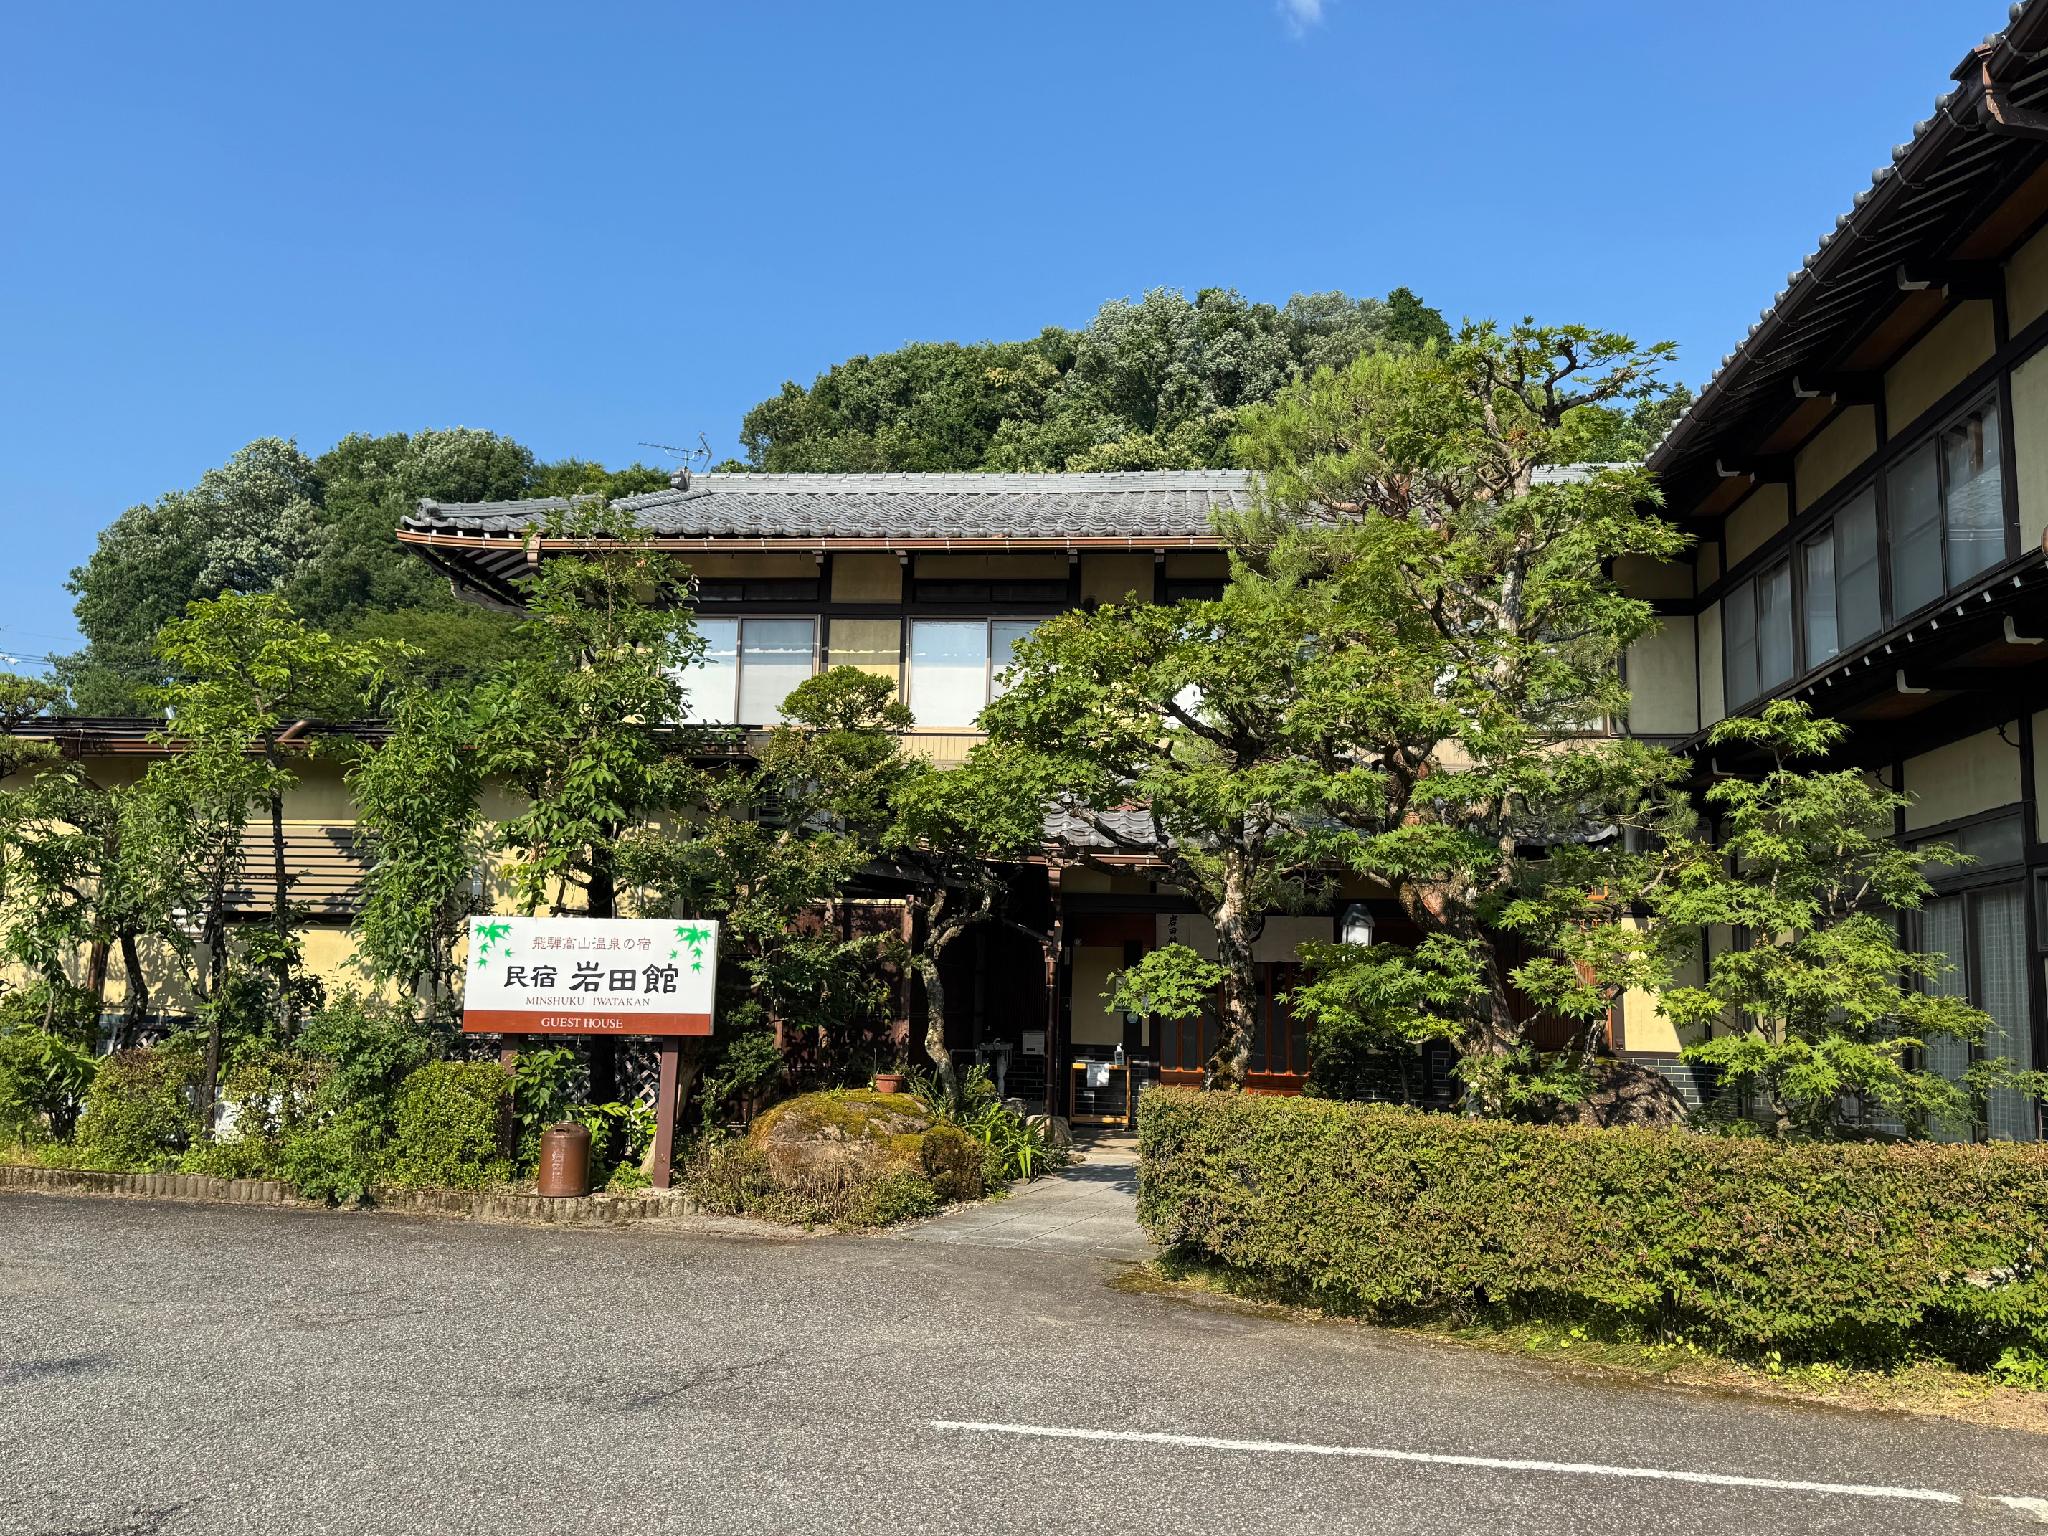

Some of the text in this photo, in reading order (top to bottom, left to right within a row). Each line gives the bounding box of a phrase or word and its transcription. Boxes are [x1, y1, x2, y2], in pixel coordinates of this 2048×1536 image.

[531, 936, 651, 951] 飛騨高山温泉の宿
[504, 961, 679, 994] 民宿 岩田館
[525, 996, 651, 1007] MINSHUKU IWATAKAN
[541, 1017, 624, 1029] GUEST HOUSE
